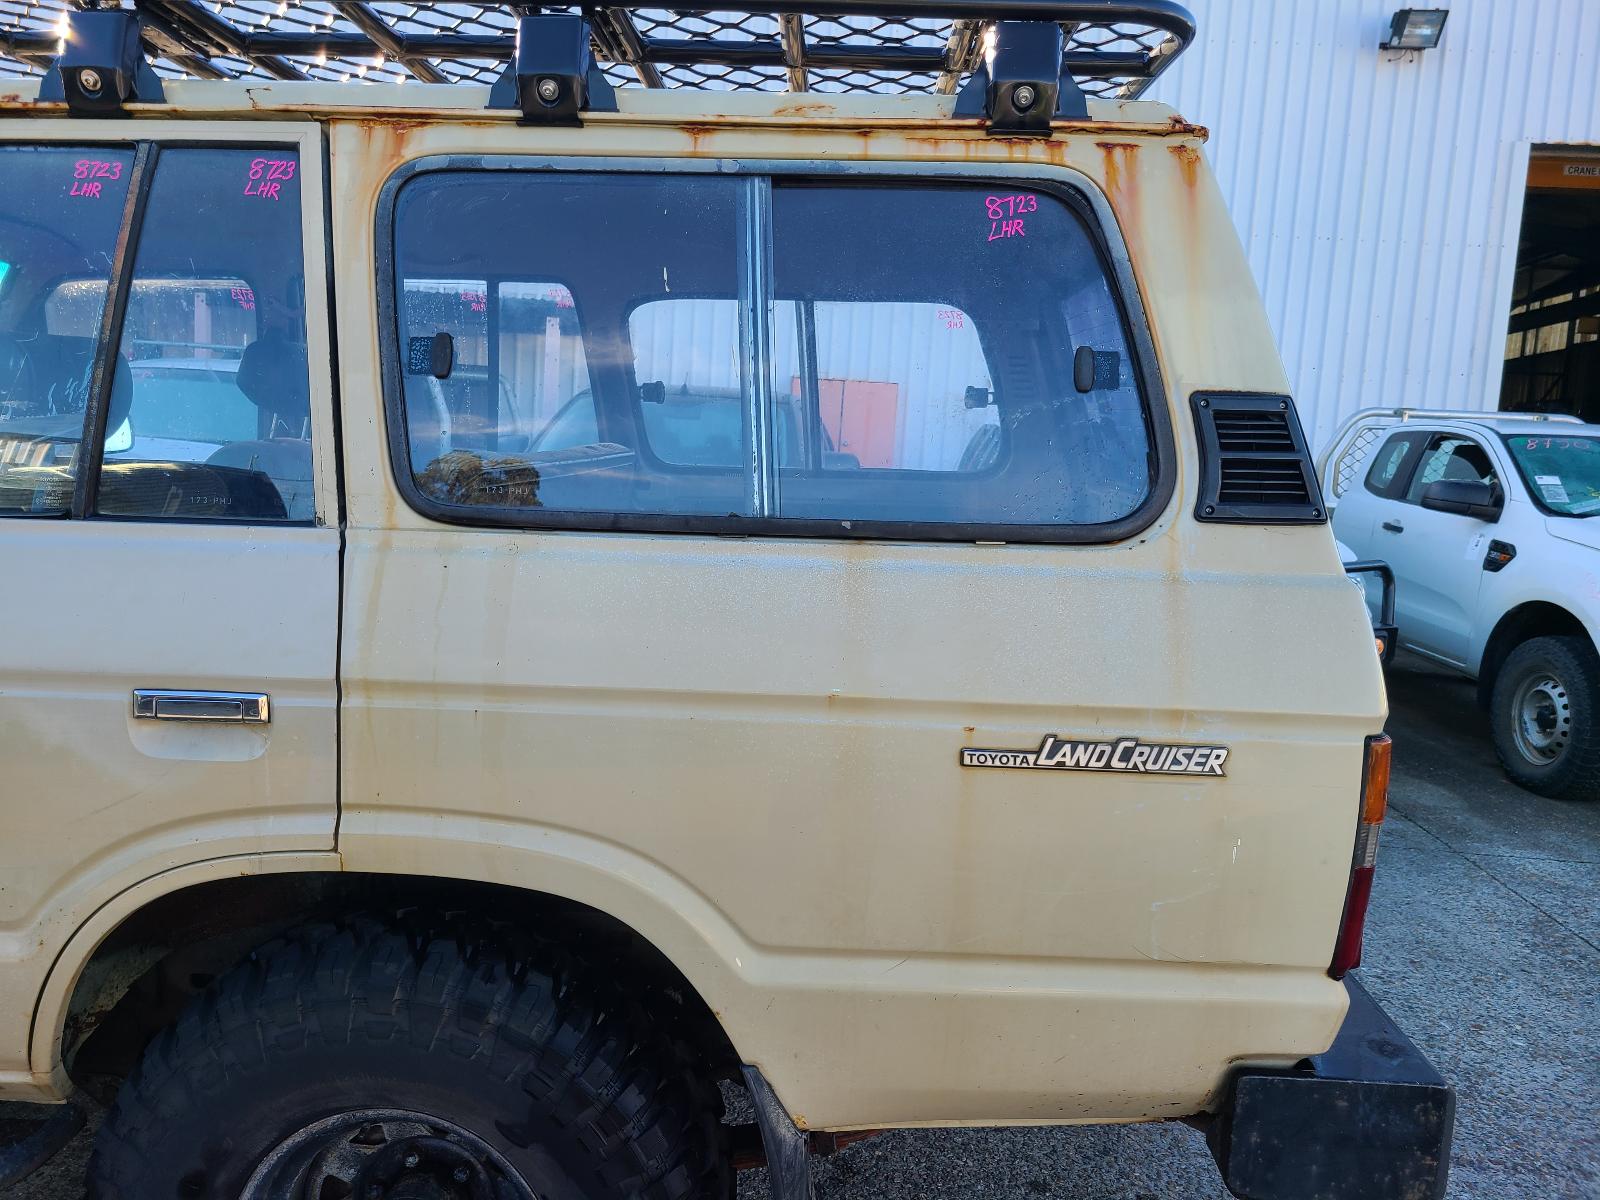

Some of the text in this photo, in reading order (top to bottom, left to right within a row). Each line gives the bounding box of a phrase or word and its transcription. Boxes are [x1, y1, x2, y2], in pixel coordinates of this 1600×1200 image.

[74, 159, 123, 180] 8723
[250, 157, 296, 181] 8723
[70, 182, 102, 199] LHR
[244, 181, 281, 201] LHR
[985, 195, 1037, 219] 8723
[988, 219, 1025, 241] LHR
[966, 752, 1031, 767] TOYOTA
